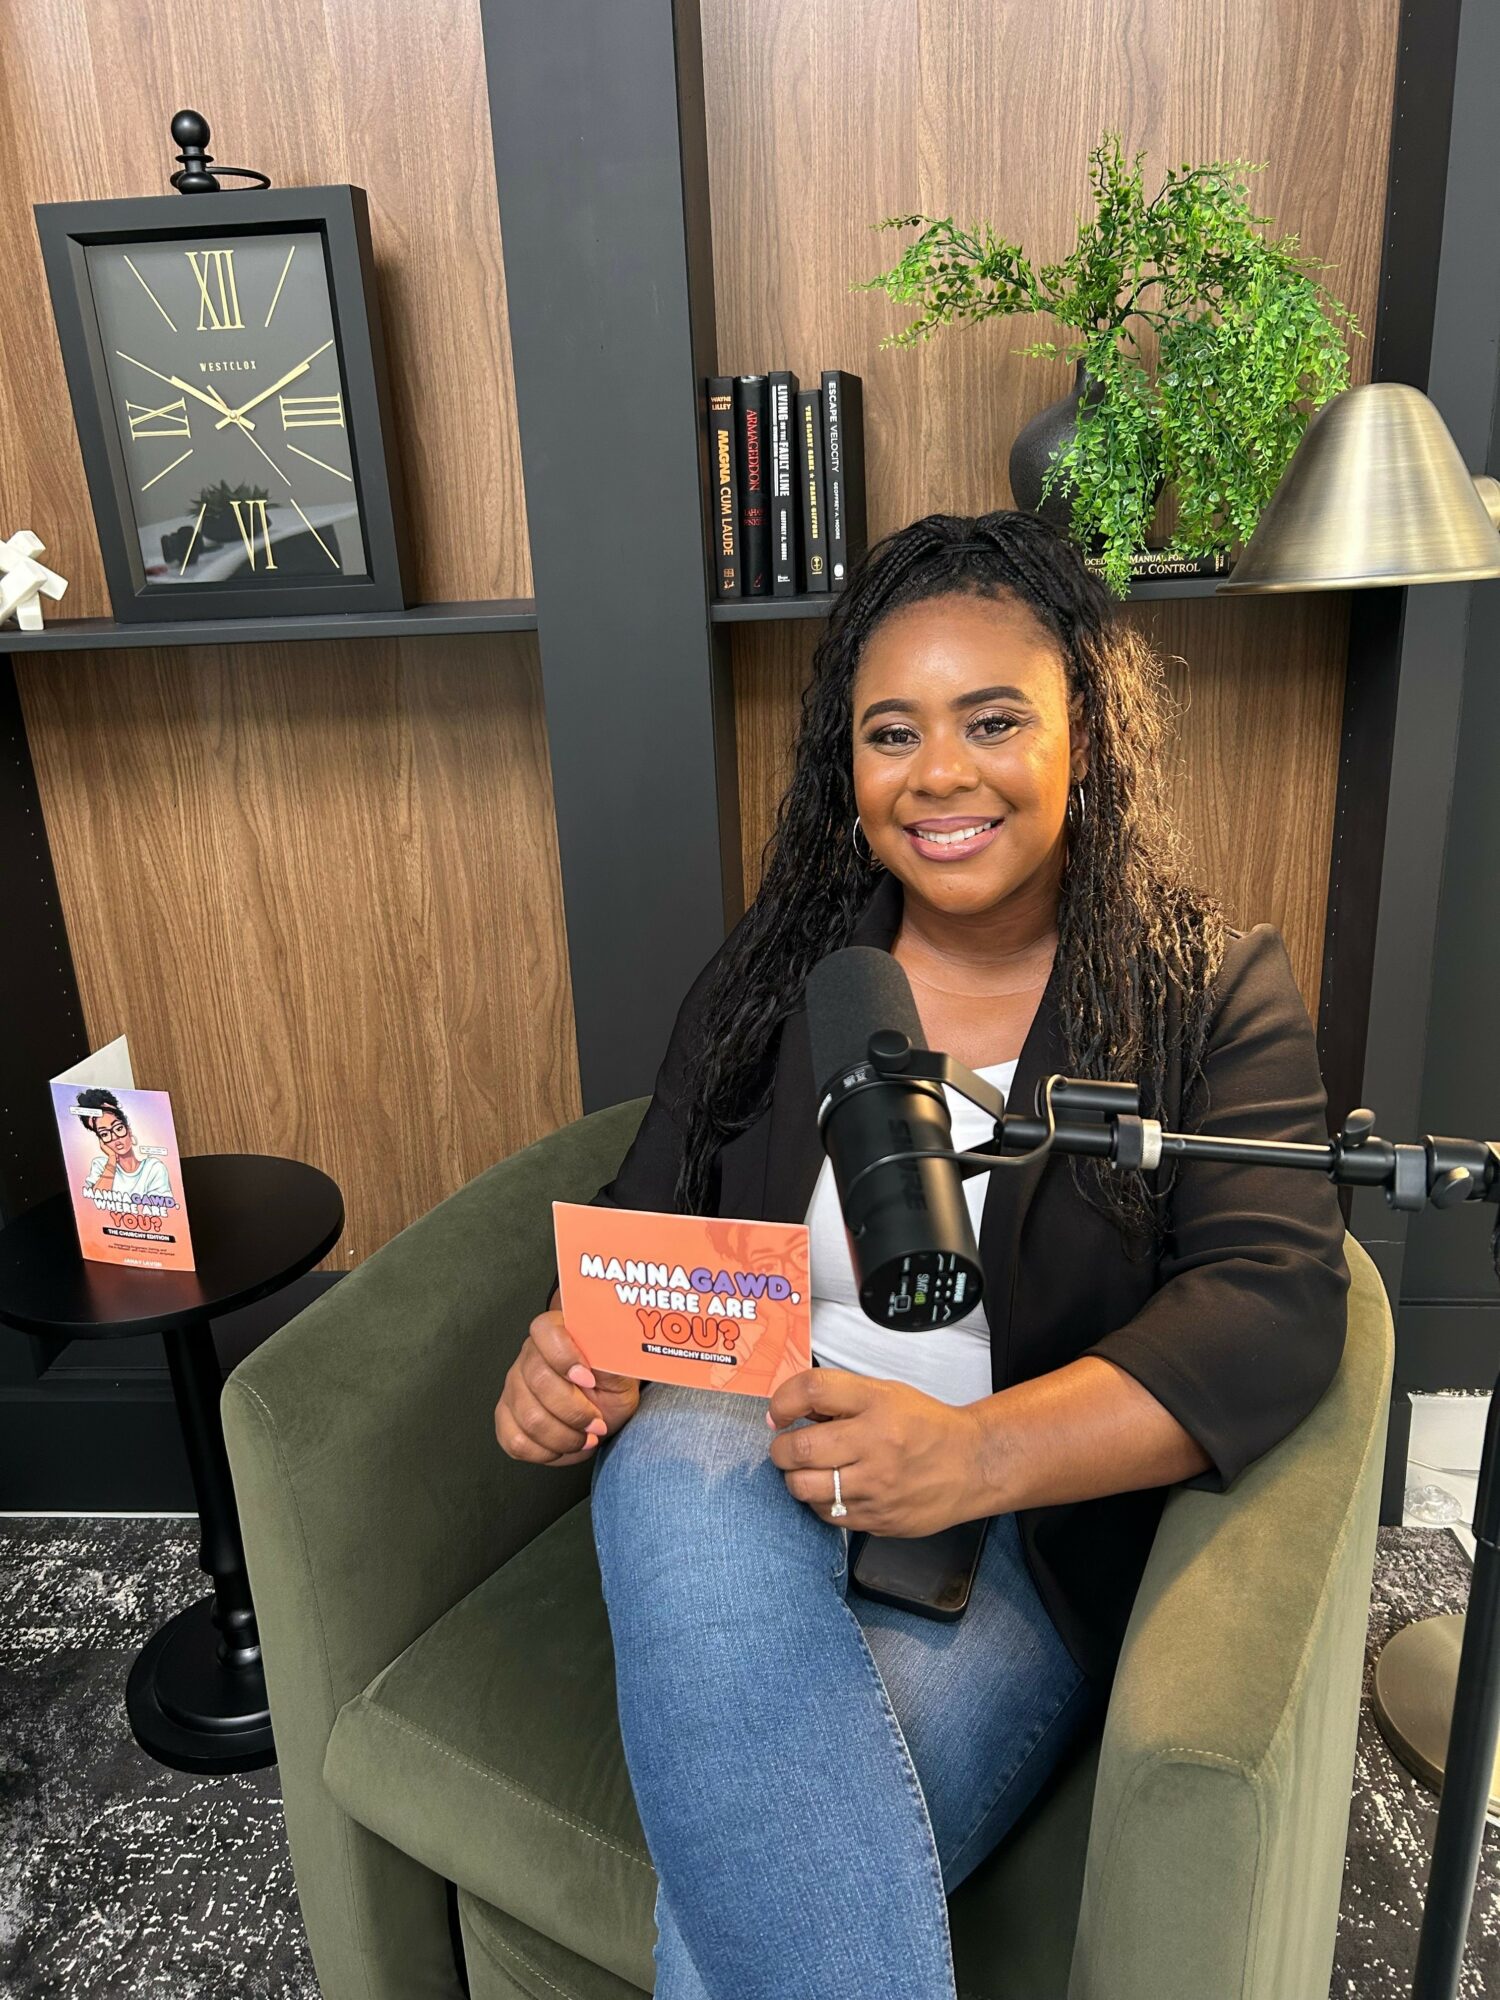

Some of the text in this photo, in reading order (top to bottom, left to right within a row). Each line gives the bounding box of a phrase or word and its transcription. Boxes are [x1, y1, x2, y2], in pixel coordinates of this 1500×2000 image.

[184, 250, 245, 330] XII
[199, 360, 256, 372] WESTCLOX
[126, 397, 191, 440] IX
[278, 392, 344, 431] III
[778, 385, 788, 420] LIVING
[828, 382, 839, 472] ESCAPE VELOCITY
[747, 409, 760, 490] ARMAGEDDON
[779, 441, 789, 470] FAULT
[718, 430, 733, 556] MAGNA CUM LAUDE
[780, 473, 789, 496] LINE
[230, 500, 278, 571] VI
[1148, 563, 1200, 574] CONTROL
[83, 1186, 180, 1210] MANNAGAWD,
[94, 1199, 168, 1218] WHERE ARE
[110, 1212, 162, 1232] YOU?
[119, 1230, 146, 1239] CHURCHY
[580, 1252, 801, 1305] MANNAGAWD,
[615, 1283, 757, 1320] WHERE ARE
[636, 1308, 740, 1350] YOU?
[647, 1344, 732, 1363] THE CHURCHY EDITION
